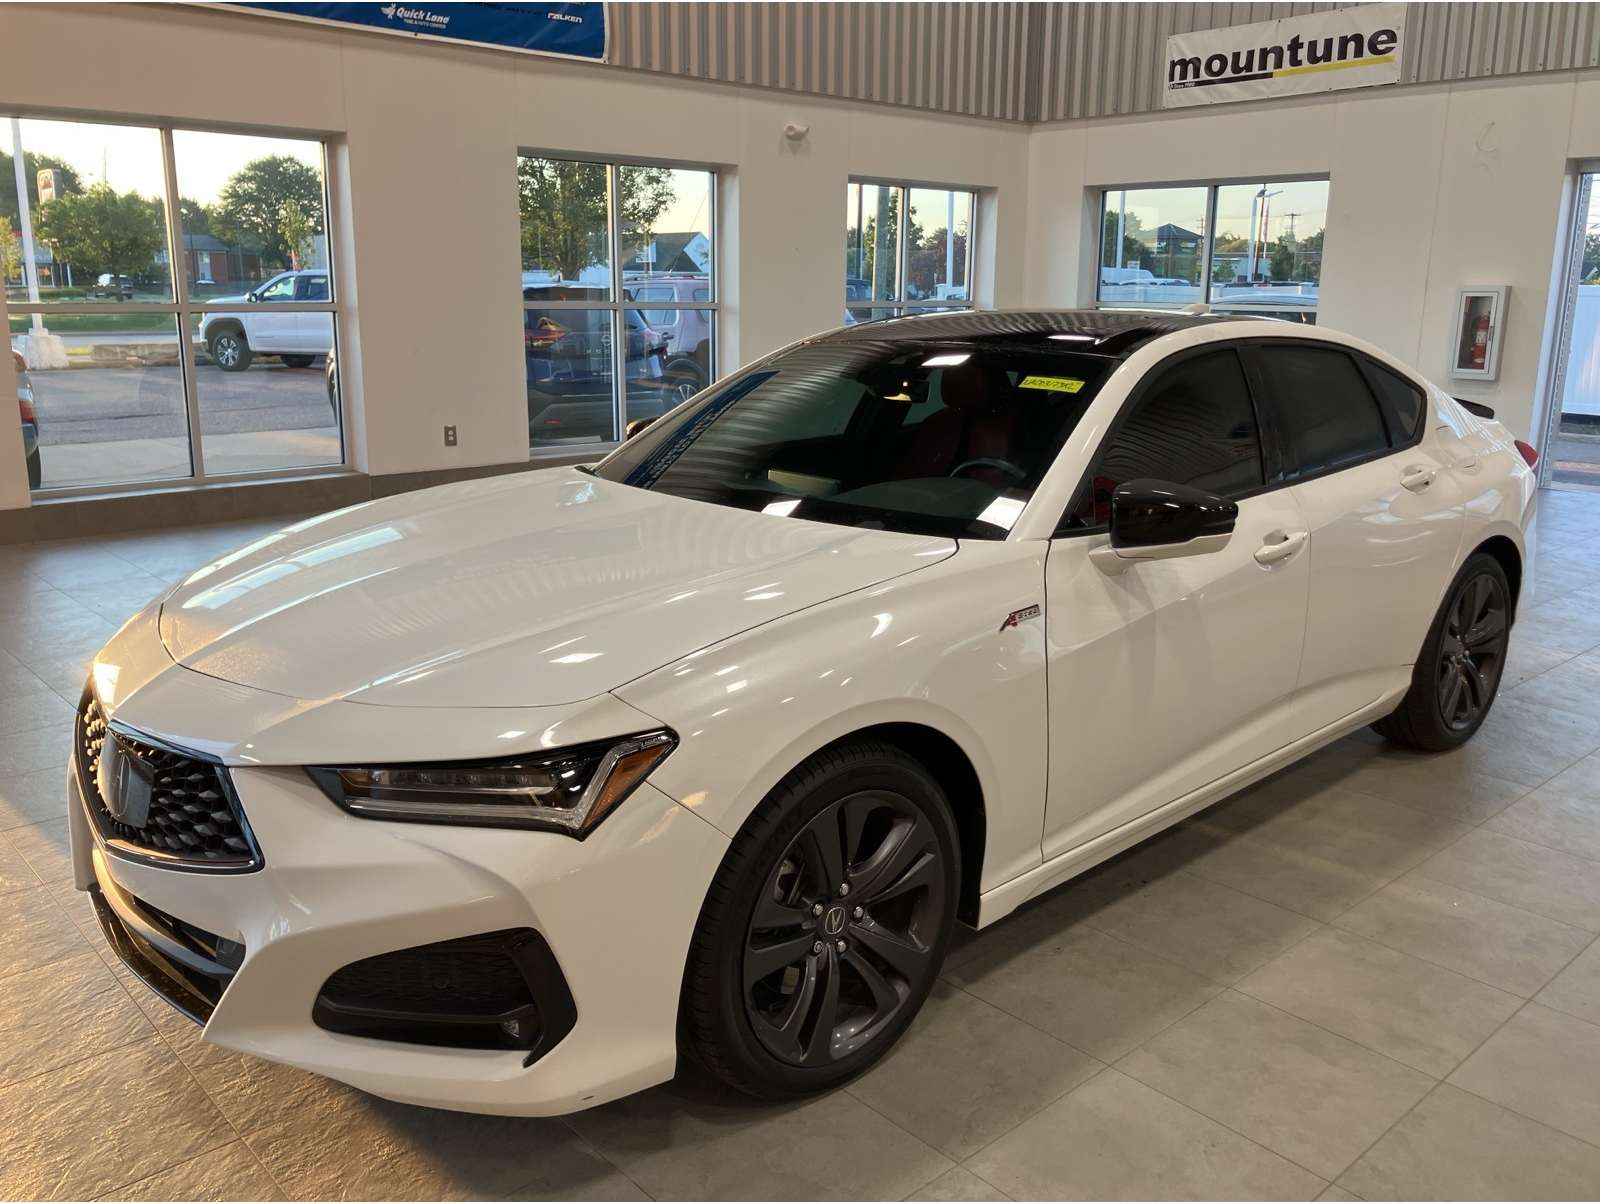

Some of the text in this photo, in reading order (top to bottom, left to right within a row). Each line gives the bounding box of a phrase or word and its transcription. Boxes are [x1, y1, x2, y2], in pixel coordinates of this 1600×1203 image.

[396, 7, 450, 24] Quick Lane
[547, 12, 583, 24] FALKEN
[1169, 29, 1397, 82] mountune
